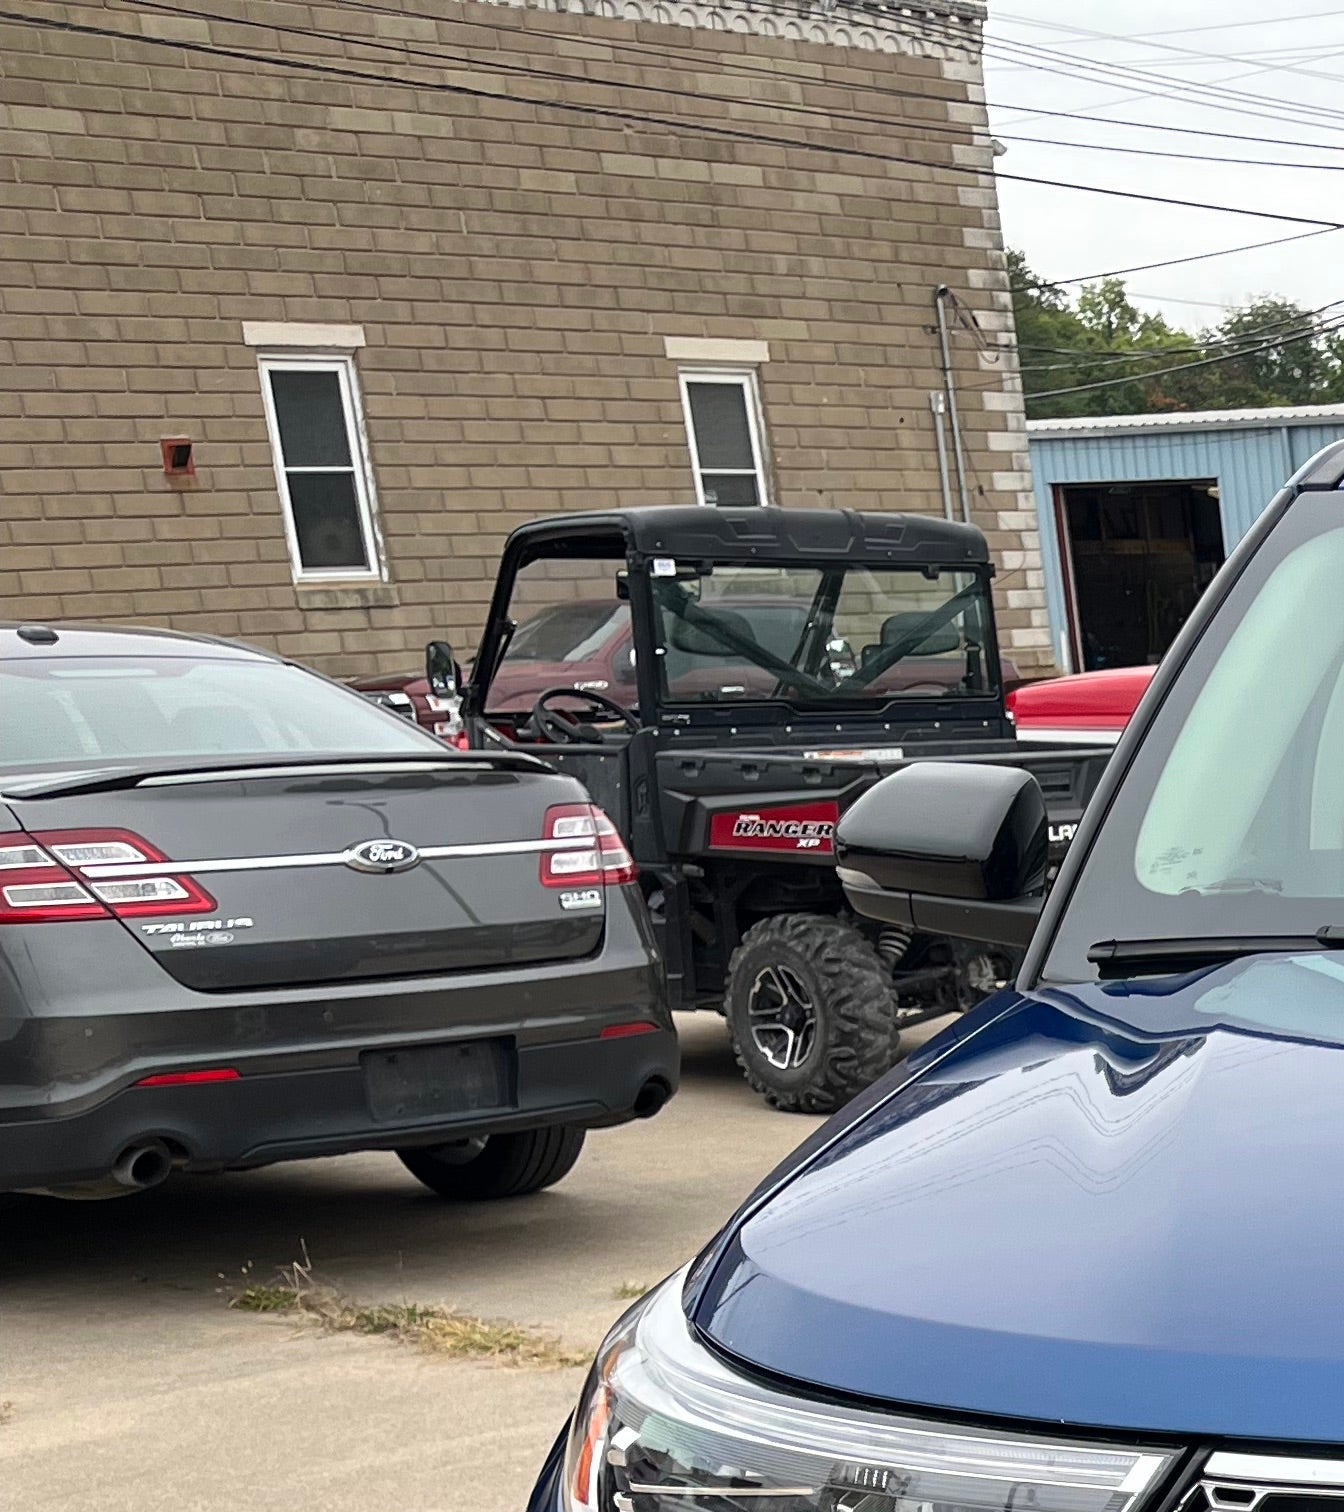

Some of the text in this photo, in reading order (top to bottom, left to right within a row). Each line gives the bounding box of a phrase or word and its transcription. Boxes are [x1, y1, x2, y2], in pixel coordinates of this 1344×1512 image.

[732, 820, 835, 838] RANGER
[797, 838, 820, 848] XP
[369, 844, 404, 862] Ford
[141, 918, 254, 935] TAURUS
